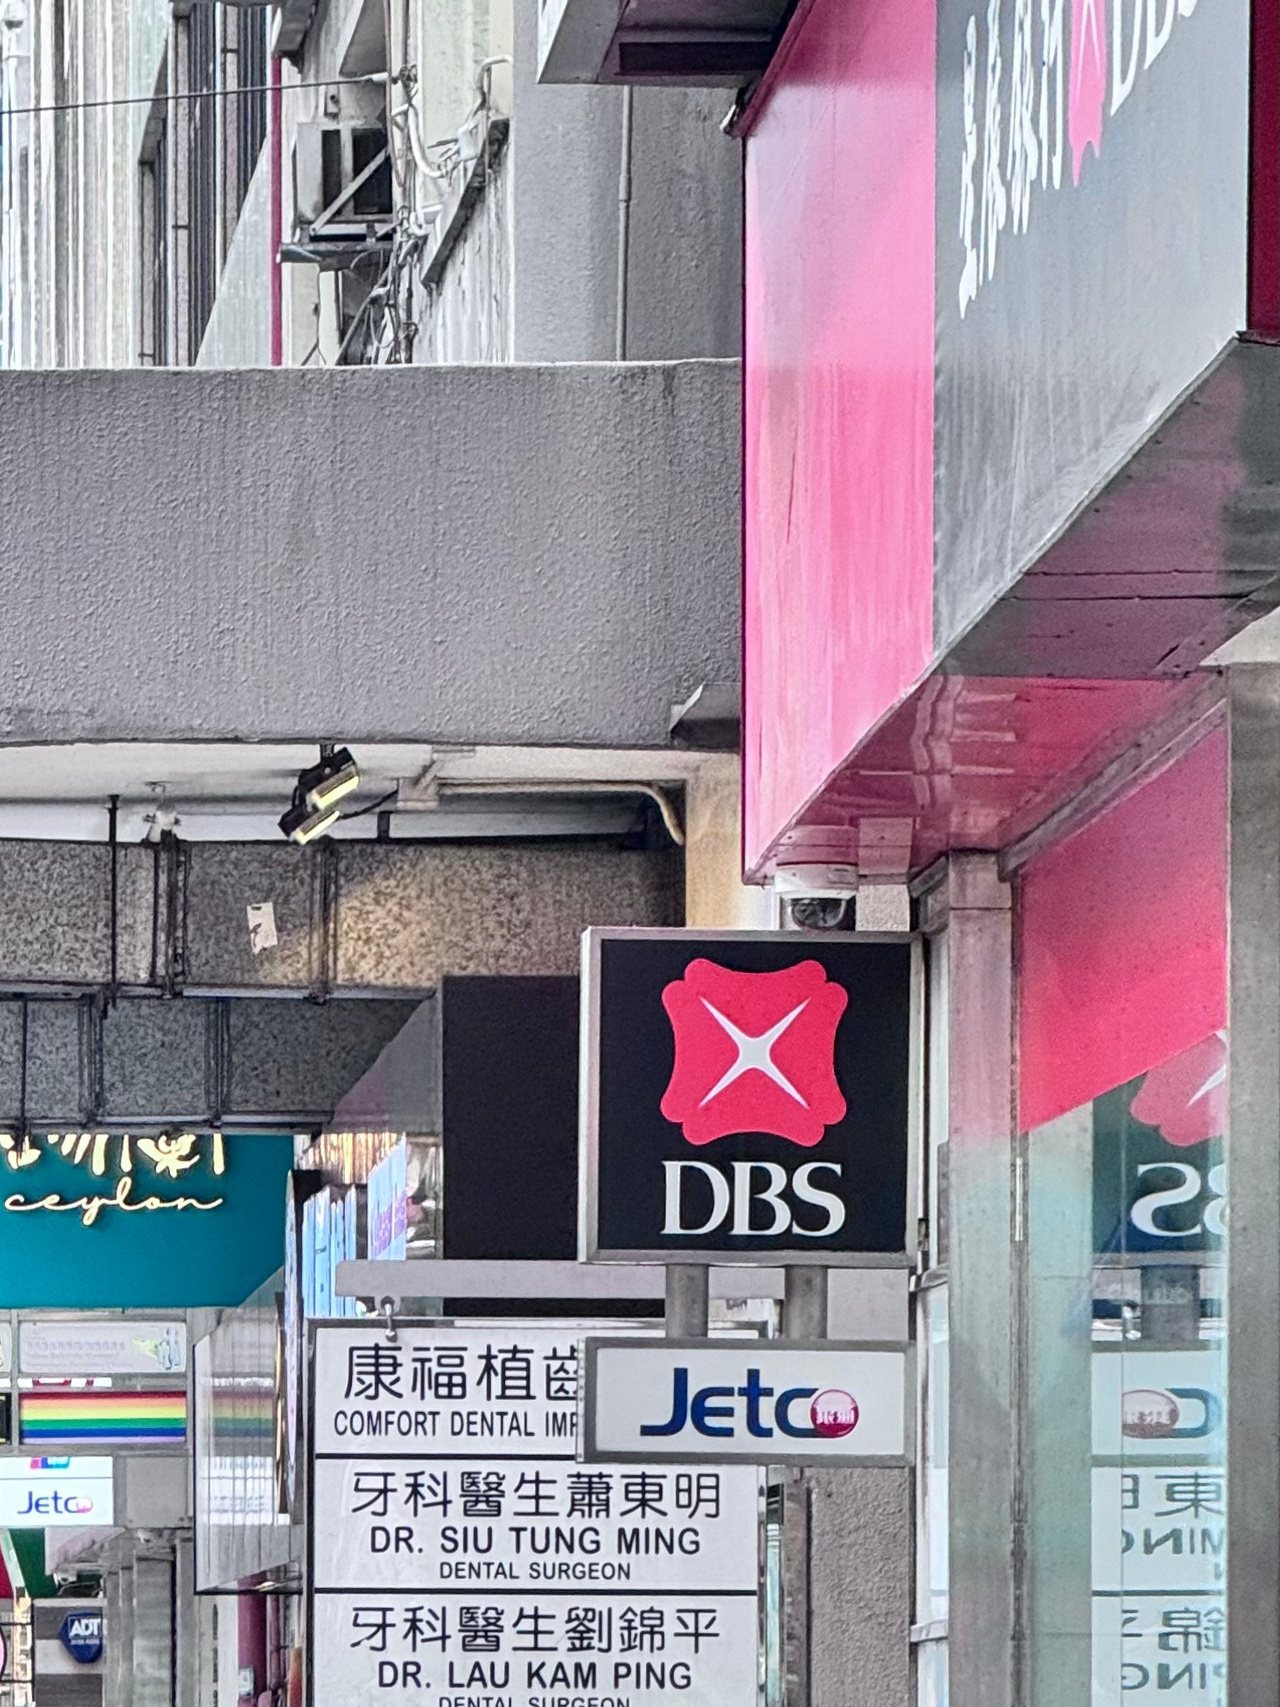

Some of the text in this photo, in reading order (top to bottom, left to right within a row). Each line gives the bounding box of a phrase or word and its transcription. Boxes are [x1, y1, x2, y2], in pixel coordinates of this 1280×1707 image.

[4, 1178, 223, 1228] ceylon
[661, 1161, 845, 1238] DBS
[333, 1410, 440, 1437] COMFORT
[450, 1410, 535, 1437] DENTAL
[350, 1470, 722, 1521] 牙科醫生蕭東明
[370, 1525, 702, 1556] DR. SIU TUNG MING
[438, 1562, 631, 1581] DENTAL SURGEON
[69, 1618, 102, 1638] ADT
[350, 1605, 721, 1656] 牙科醫生劉錦平
[377, 1662, 693, 1691] DR. LAU KAM PING
